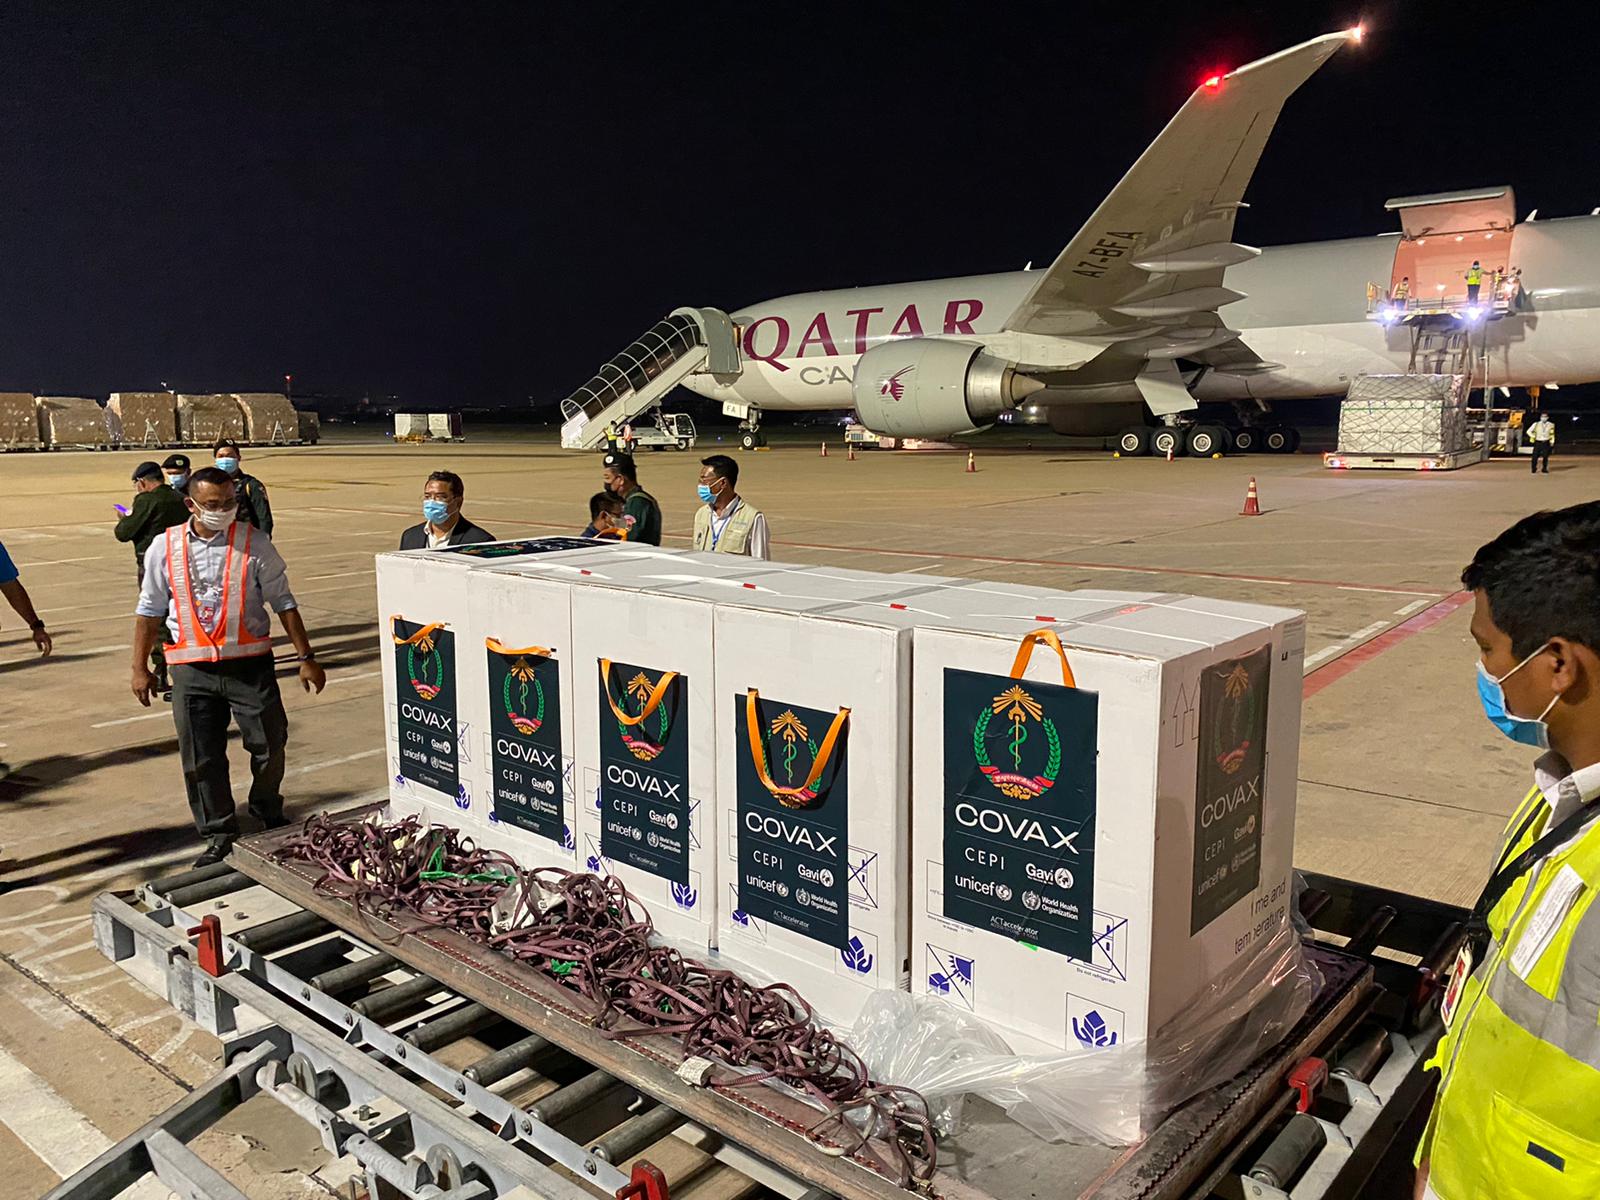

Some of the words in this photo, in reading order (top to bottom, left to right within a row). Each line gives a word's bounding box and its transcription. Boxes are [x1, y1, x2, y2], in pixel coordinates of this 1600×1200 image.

[1072, 231, 1143, 278] A7-BFA
[743, 299, 984, 372] QATAR
[800, 364, 858, 386] CA
[726, 404, 736, 414] FA
[402, 703, 453, 733] COVAX
[406, 730, 424, 745] CEPI
[403, 748, 420, 761] unicef
[497, 739, 556, 771] COVAX
[503, 769, 523, 784] CEPI
[531, 777, 546, 789] Gavi
[607, 765, 681, 803] COVAX
[499, 788, 518, 802] unicef
[1201, 775, 1260, 828] COVAX
[613, 799, 638, 816] CEPI
[649, 809, 667, 824] Gavi
[607, 821, 632, 837] unicef
[745, 812, 838, 858] COVAX
[955, 803, 1080, 855] COVAX
[964, 847, 1005, 870] CEPI
[1205, 838, 1225, 861] CEPI
[753, 850, 783, 871] CEPI
[797, 864, 820, 881] Gavi
[1025, 863, 1054, 882] Gavi
[746, 874, 777, 893] unicef
[955, 875, 995, 896] unicef
[1270, 876, 1287, 903] and
[1041, 895, 1059, 908] World
[1059, 900, 1079, 913] Health
[1041, 904, 1079, 921] Organization
